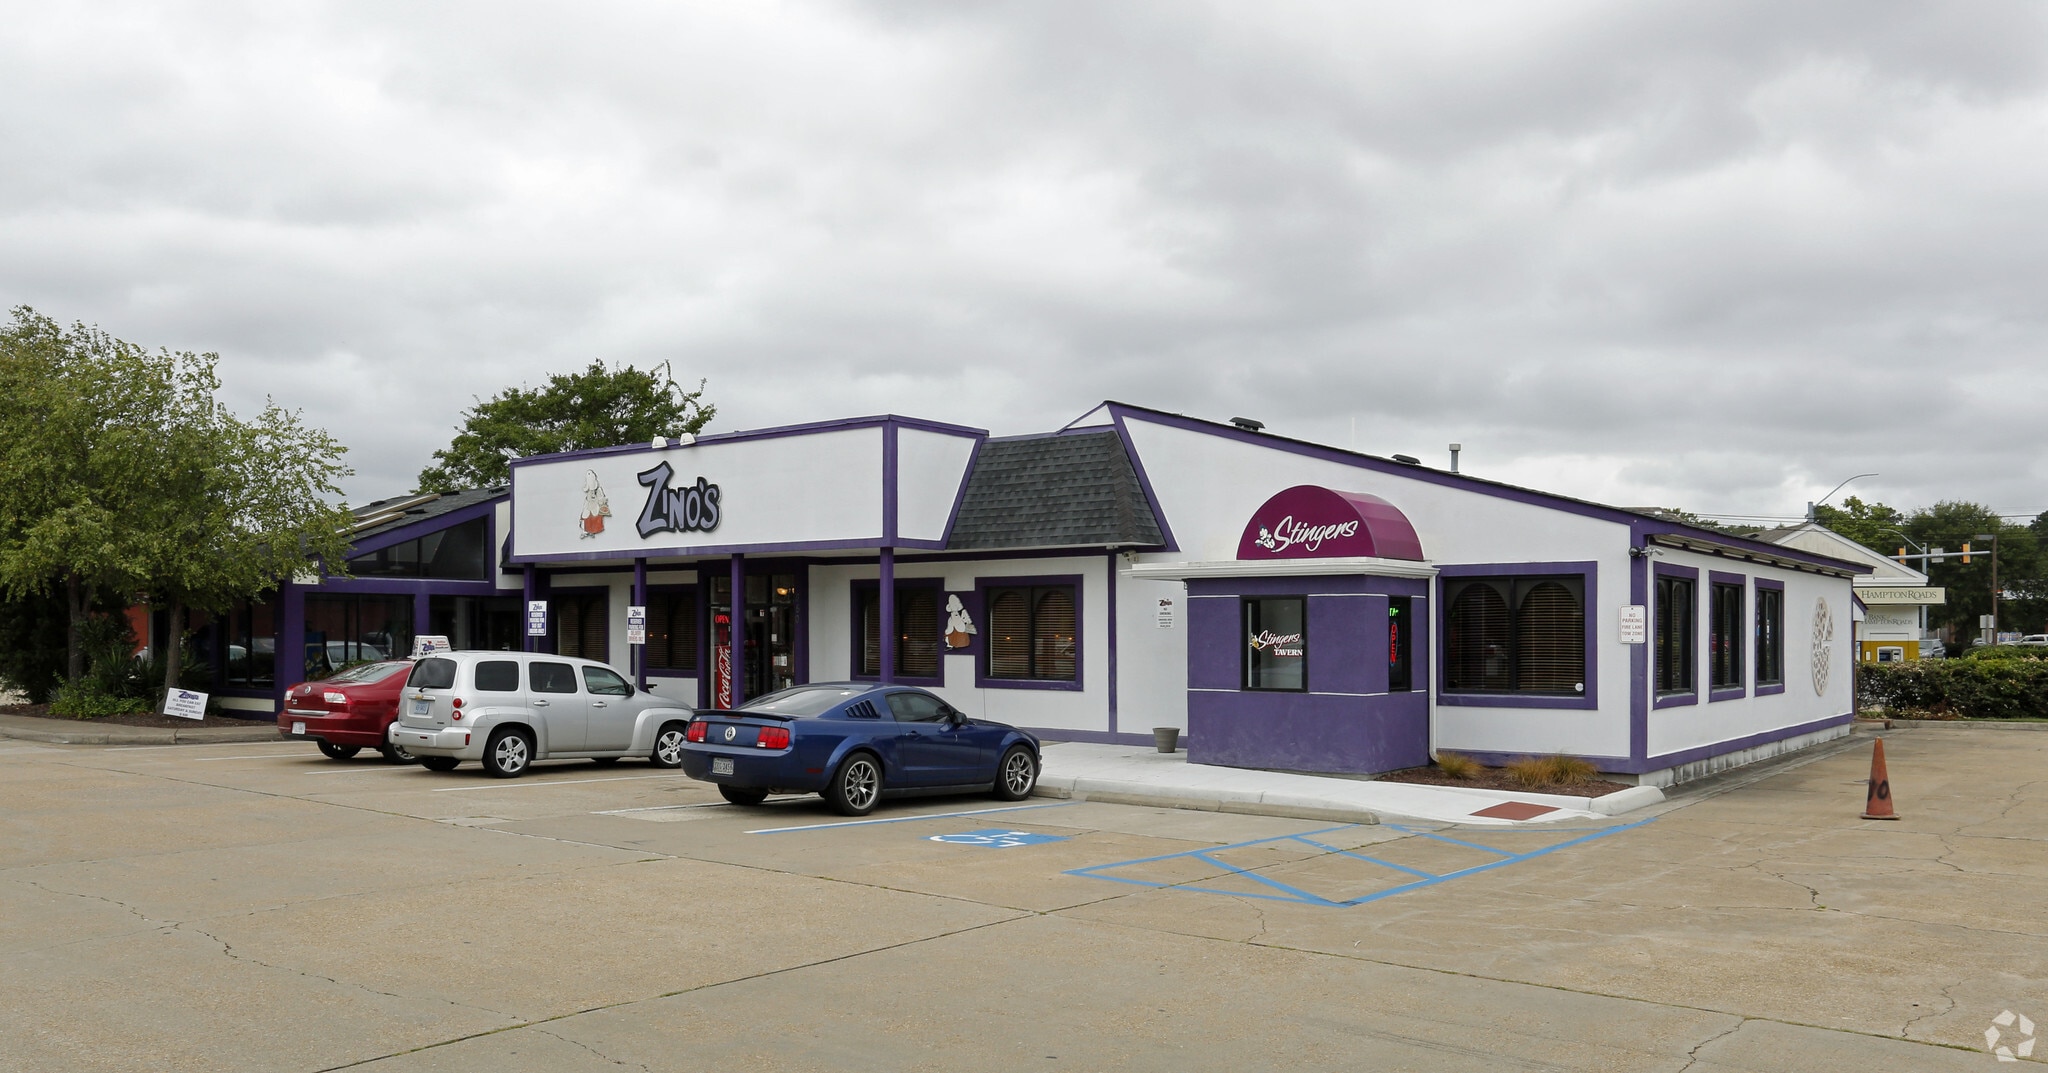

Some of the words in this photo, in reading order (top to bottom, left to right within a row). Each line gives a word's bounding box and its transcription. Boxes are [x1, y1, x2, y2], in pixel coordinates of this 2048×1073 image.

[1271, 515, 1359, 552] Stingers
[714, 614, 730, 623] OPEN
[1257, 630, 1301, 650] Stingers
[1274, 649, 1303, 657] TAVERN
